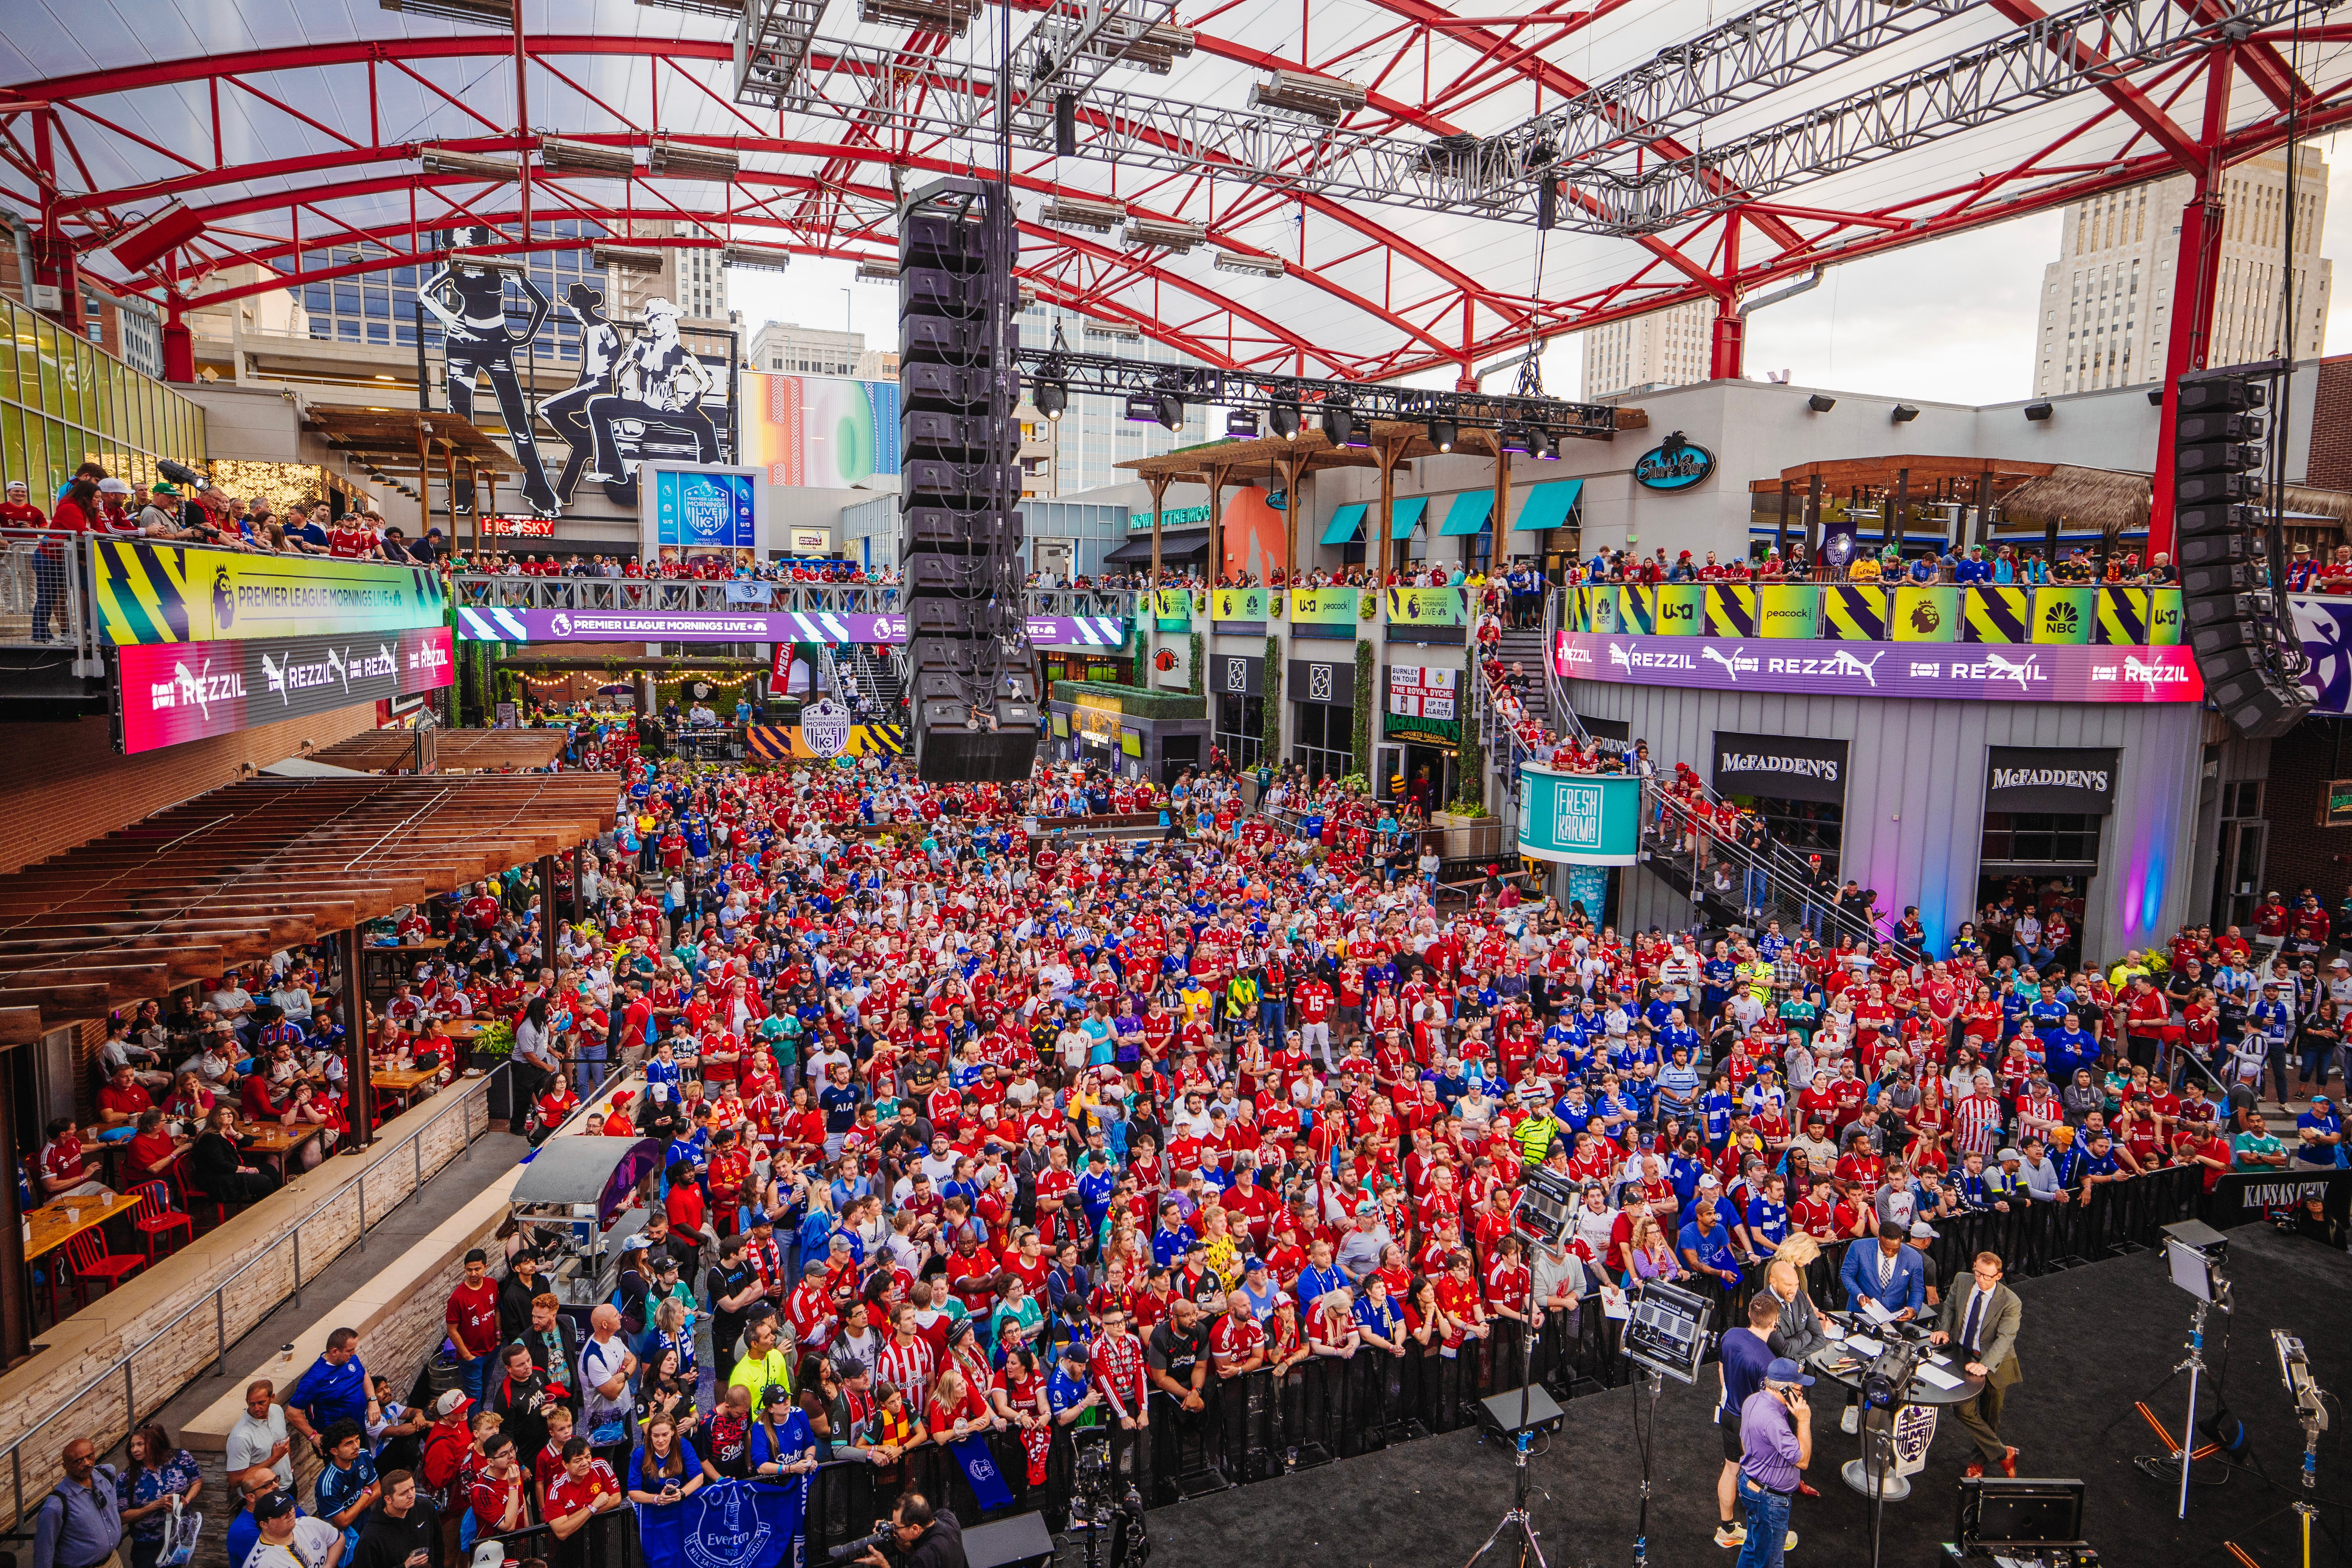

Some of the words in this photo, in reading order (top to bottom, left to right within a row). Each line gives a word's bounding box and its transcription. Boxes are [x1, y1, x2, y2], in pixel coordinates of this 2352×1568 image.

[1638, 458, 1674, 480] Shark
[1678, 454, 1704, 476] Bar
[696, 507, 718, 515] LIVE
[1131, 513, 1154, 529] HOWL
[1161, 511, 1169, 526] T
[1169, 508, 1187, 524] THE
[1187, 505, 1210, 523] MOO
[485, 519, 510, 532] BIG
[523, 521, 552, 534] SKY
[238, 586, 287, 607] PREMIER
[290, 588, 327, 607] LEAGUE
[330, 589, 372, 607] MORNINGS
[374, 590, 388, 607] LIVE
[1323, 601, 1348, 613] peacock
[1766, 607, 1808, 620] peacock
[574, 620, 622, 629] PREMIER
[623, 621, 665, 630] LEAGUE
[667, 621, 723, 631] MORNINGS
[724, 622, 746, 631] LIVE
[1597, 615, 1610, 624] NBC
[2046, 623, 2077, 633] NBC
[421, 650, 448, 668] REZZIL
[1563, 647, 1593, 663] REZZIL
[1631, 652, 1697, 669] REZZIL
[365, 655, 398, 677] REZZIL
[1768, 657, 1862, 675] REZZIL
[1951, 662, 2047, 680] REZZIL
[2124, 665, 2189, 682] REZZIL
[289, 663, 334, 689] REZZIL
[181, 673, 247, 705] REZZIL
[1407, 687, 1428, 696] ROYAL
[1430, 689, 1453, 698] DYCHE
[1425, 708, 1452, 716] CLARETS
[1385, 713, 1459, 741] McFADDEN'S
[1086, 730, 1110, 745] PENDERGAST
[1424, 732, 1445, 740] SALOON
[1722, 753, 1838, 781] McFADDEN'S
[1992, 768, 2108, 791] McFADDEN'S
[1559, 788, 1597, 816] FRESH
[1558, 814, 1596, 842] KARMA
[1308, 995, 1324, 1012] 15
[835, 1102, 853, 1112] AIA
[2243, 1185, 2297, 1209] KANSAS
[1659, 1298, 1678, 1310] VORTEX
[527, 1390, 545, 1415] AXA
[721, 1441, 744, 1461] Stake
[708, 1532, 750, 1546] Everton
[690, 1548, 700, 1560] NIL
